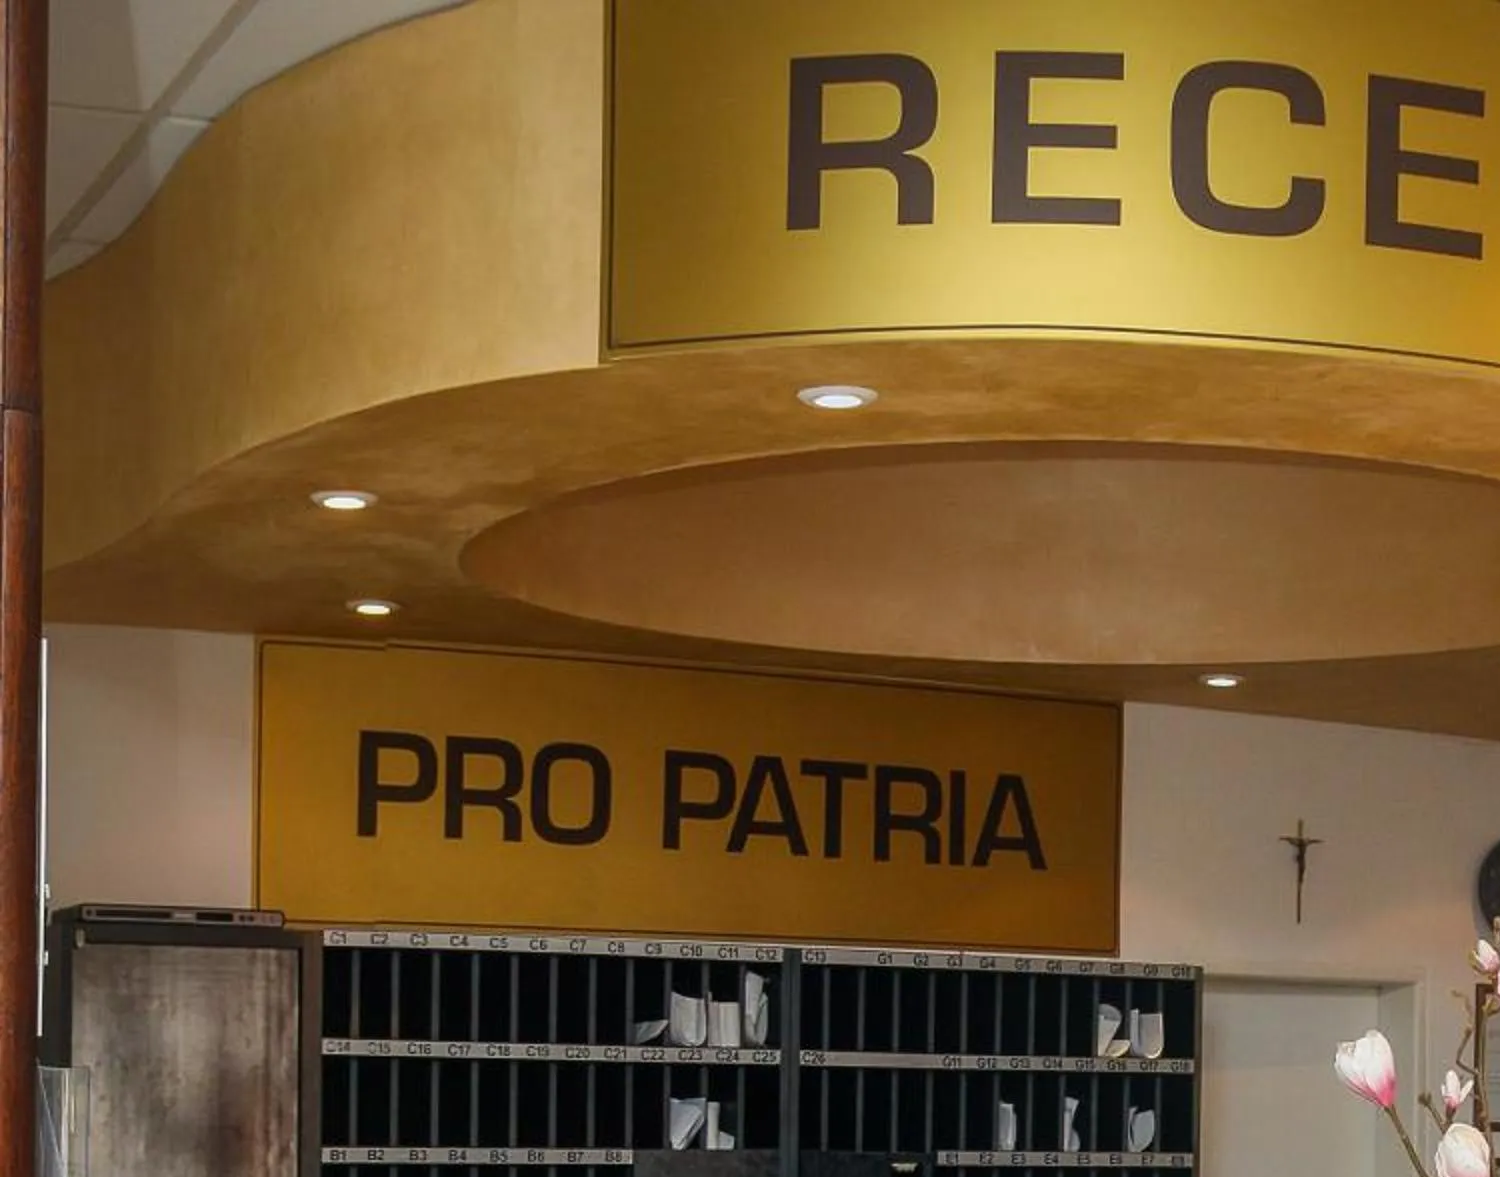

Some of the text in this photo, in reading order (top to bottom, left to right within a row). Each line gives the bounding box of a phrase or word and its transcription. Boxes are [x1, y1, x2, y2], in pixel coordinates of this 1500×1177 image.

[356, 729, 1048, 871] PRO PATRIA
[370, 933, 389, 945] C2
[410, 933, 429, 946] C3
[450, 935, 469, 947] C4
[489, 937, 508, 949] C5
[529, 938, 548, 950] C6
[569, 939, 587, 951] C7
[367, 1150, 385, 1161] B2
